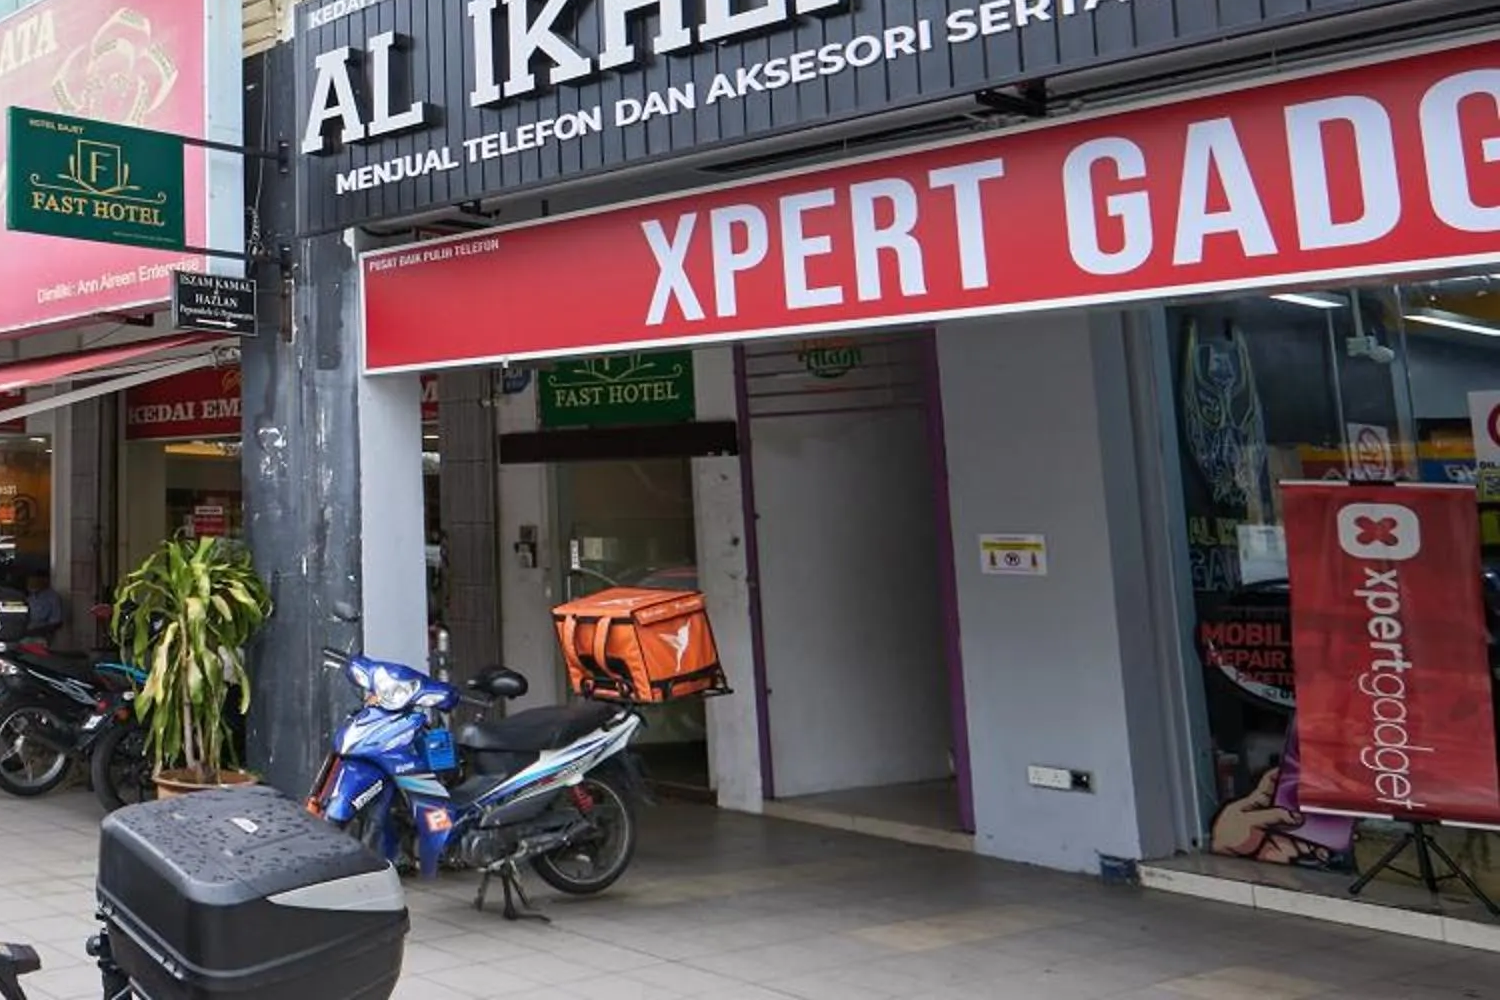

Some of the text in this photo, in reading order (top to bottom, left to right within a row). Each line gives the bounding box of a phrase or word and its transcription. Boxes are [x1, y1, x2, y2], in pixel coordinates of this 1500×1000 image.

[301, 31, 424, 155] AL
[335, 144, 459, 195] MENJUAL
[463, 106, 603, 163] TELEFON
[615, 82, 696, 129] DAN
[706, 23, 932, 106] AKSESORI
[90, 150, 113, 183] F
[639, 68, 1500, 327] XPERT GADG
[32, 191, 166, 227] FAST HOTEL
[129, 400, 196, 424] KEDAI
[555, 381, 680, 407] FAST HOTEL
[1353, 567, 1435, 810] xpertgadget
